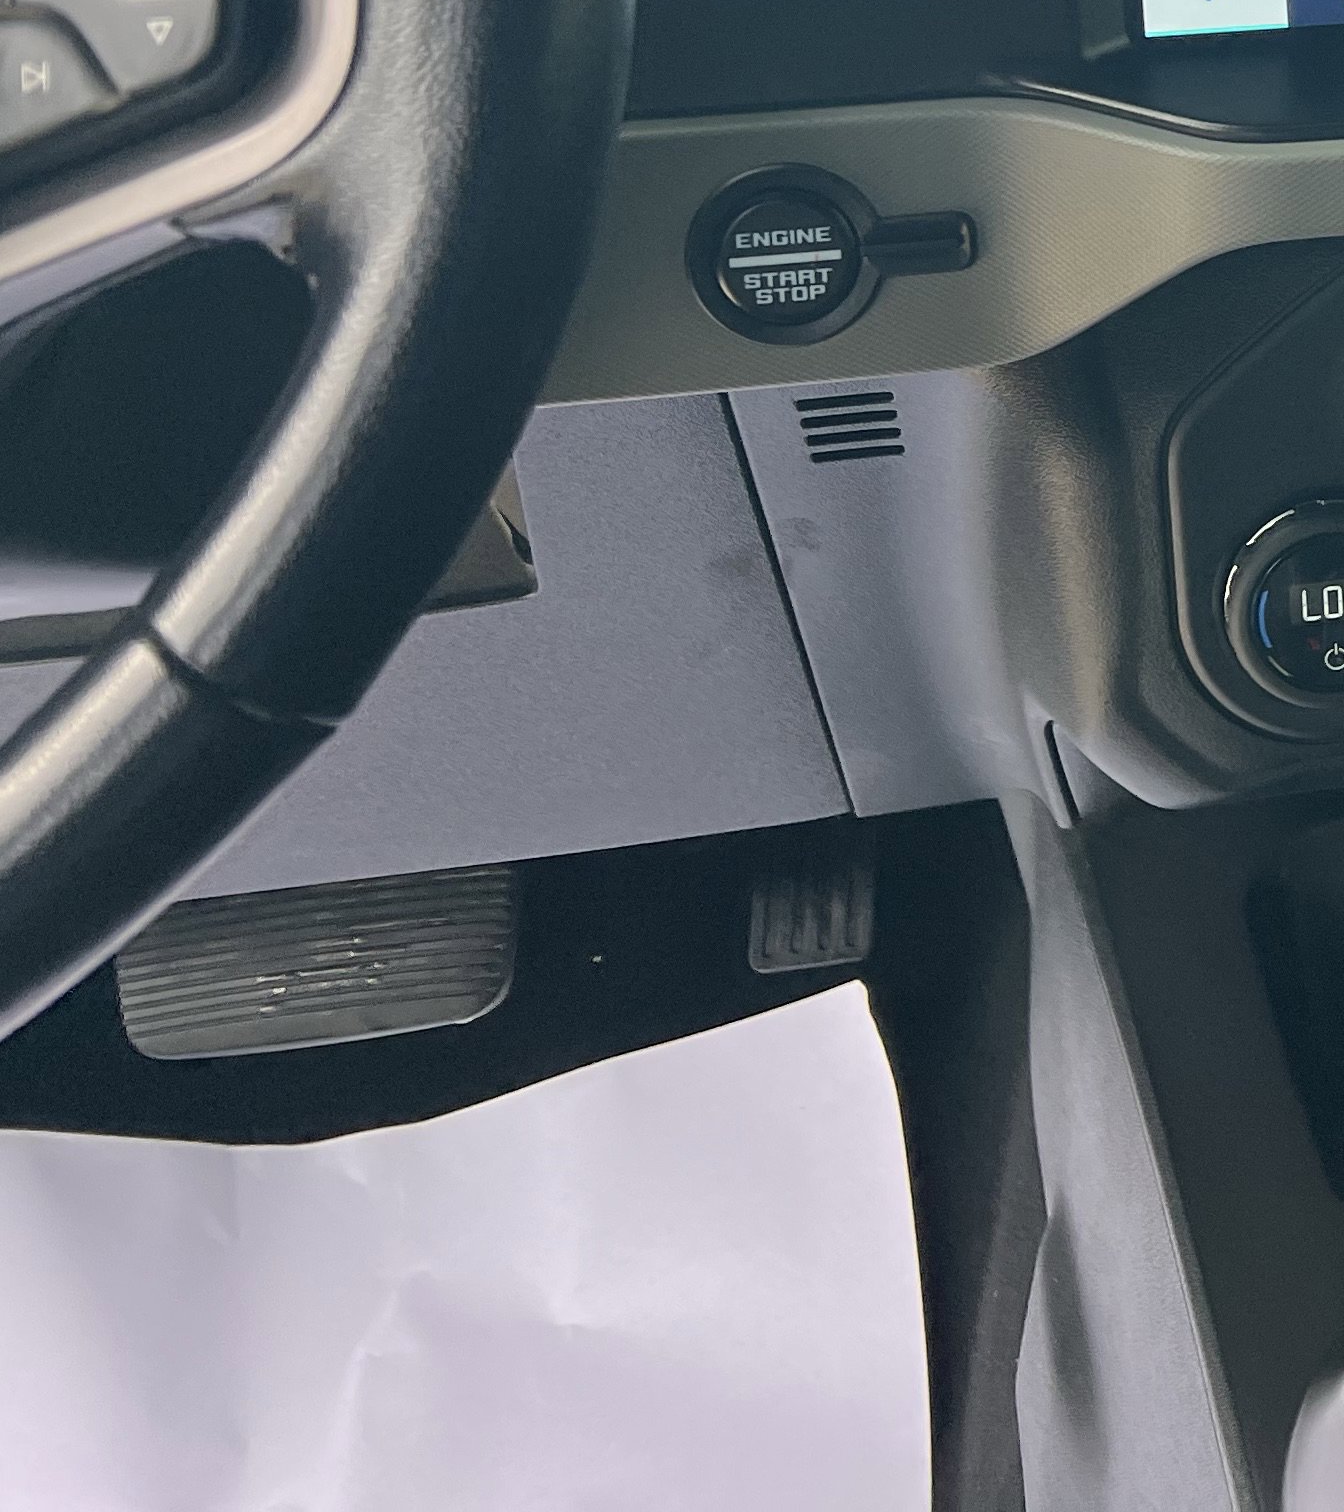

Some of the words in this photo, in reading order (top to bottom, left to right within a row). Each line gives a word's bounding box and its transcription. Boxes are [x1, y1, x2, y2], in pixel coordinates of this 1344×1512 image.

[735, 226, 831, 249] ENGINE
[744, 267, 832, 289] START
[756, 284, 826, 305] STOP
[1301, 585, 1344, 623] LO
